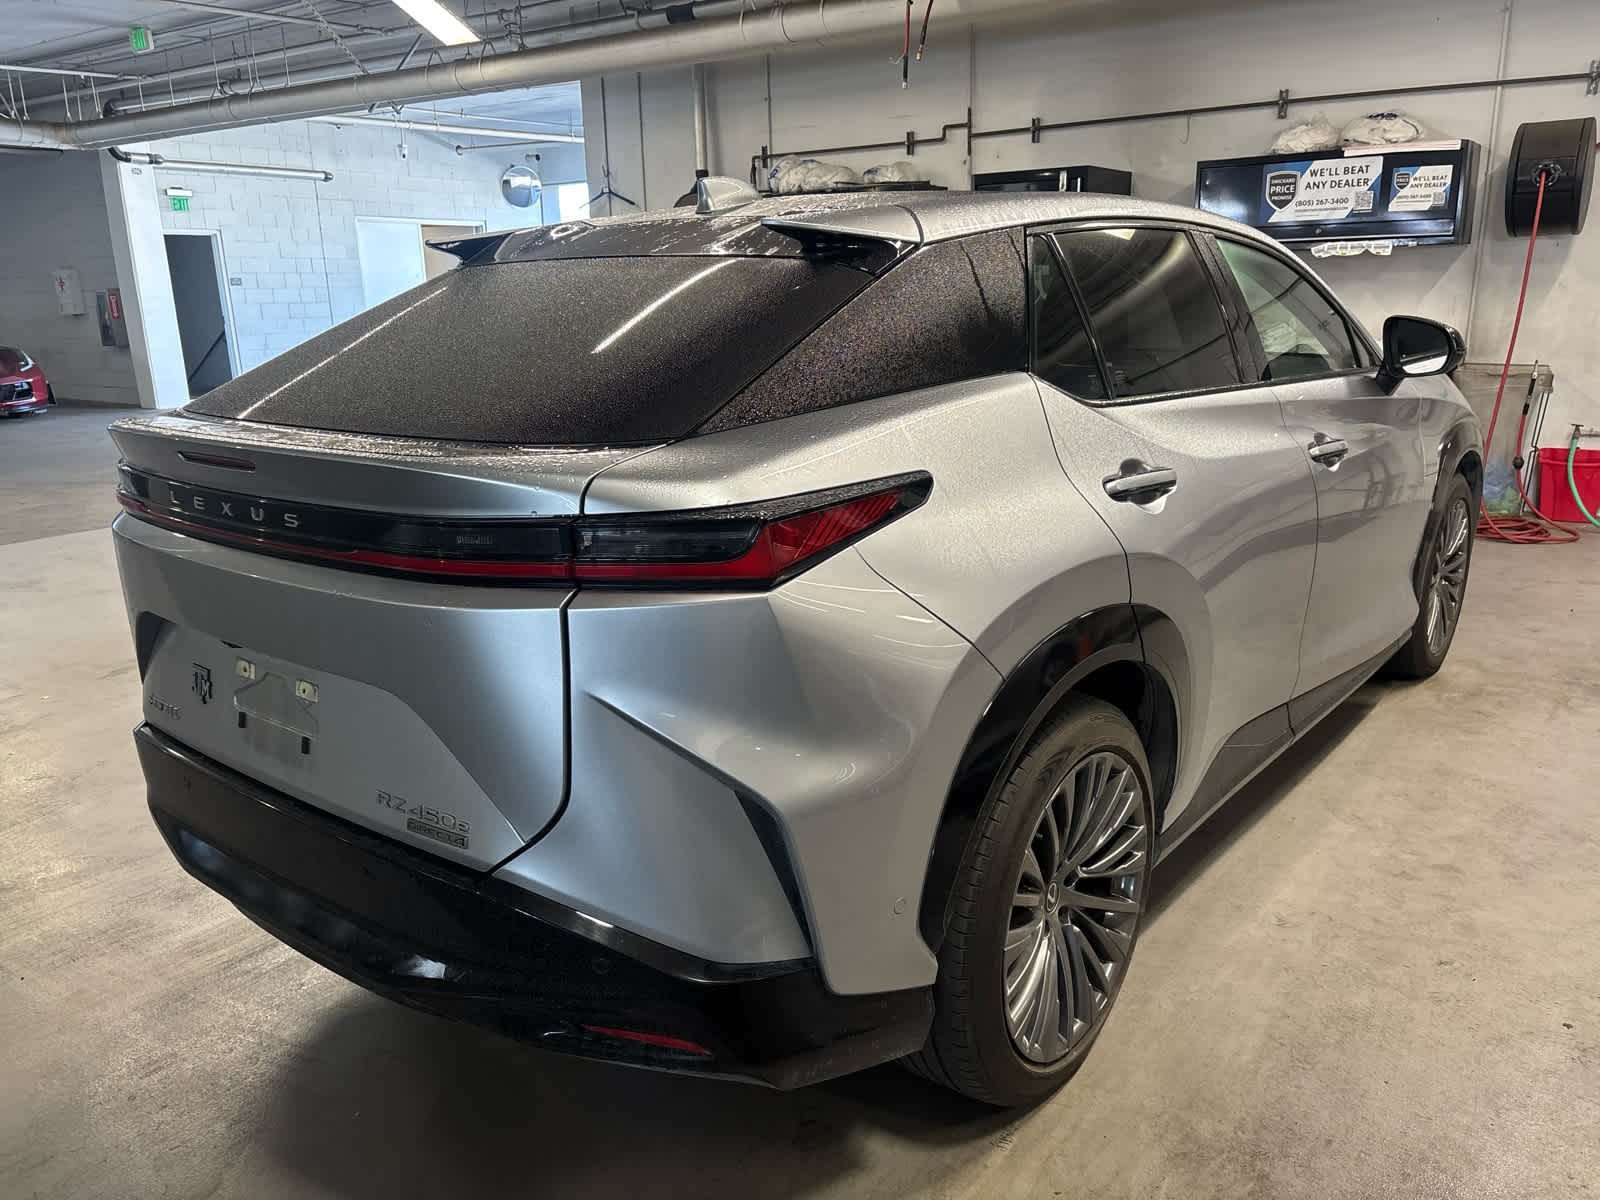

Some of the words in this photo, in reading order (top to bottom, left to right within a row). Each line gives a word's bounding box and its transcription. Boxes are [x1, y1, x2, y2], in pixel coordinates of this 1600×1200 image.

[1310, 168, 1340, 178] WE'LL
[1343, 165, 1371, 175] BEAT
[1270, 184, 1295, 194] PRICE
[1304, 180, 1329, 190] ANY
[167, 489, 299, 528] LEXUS
